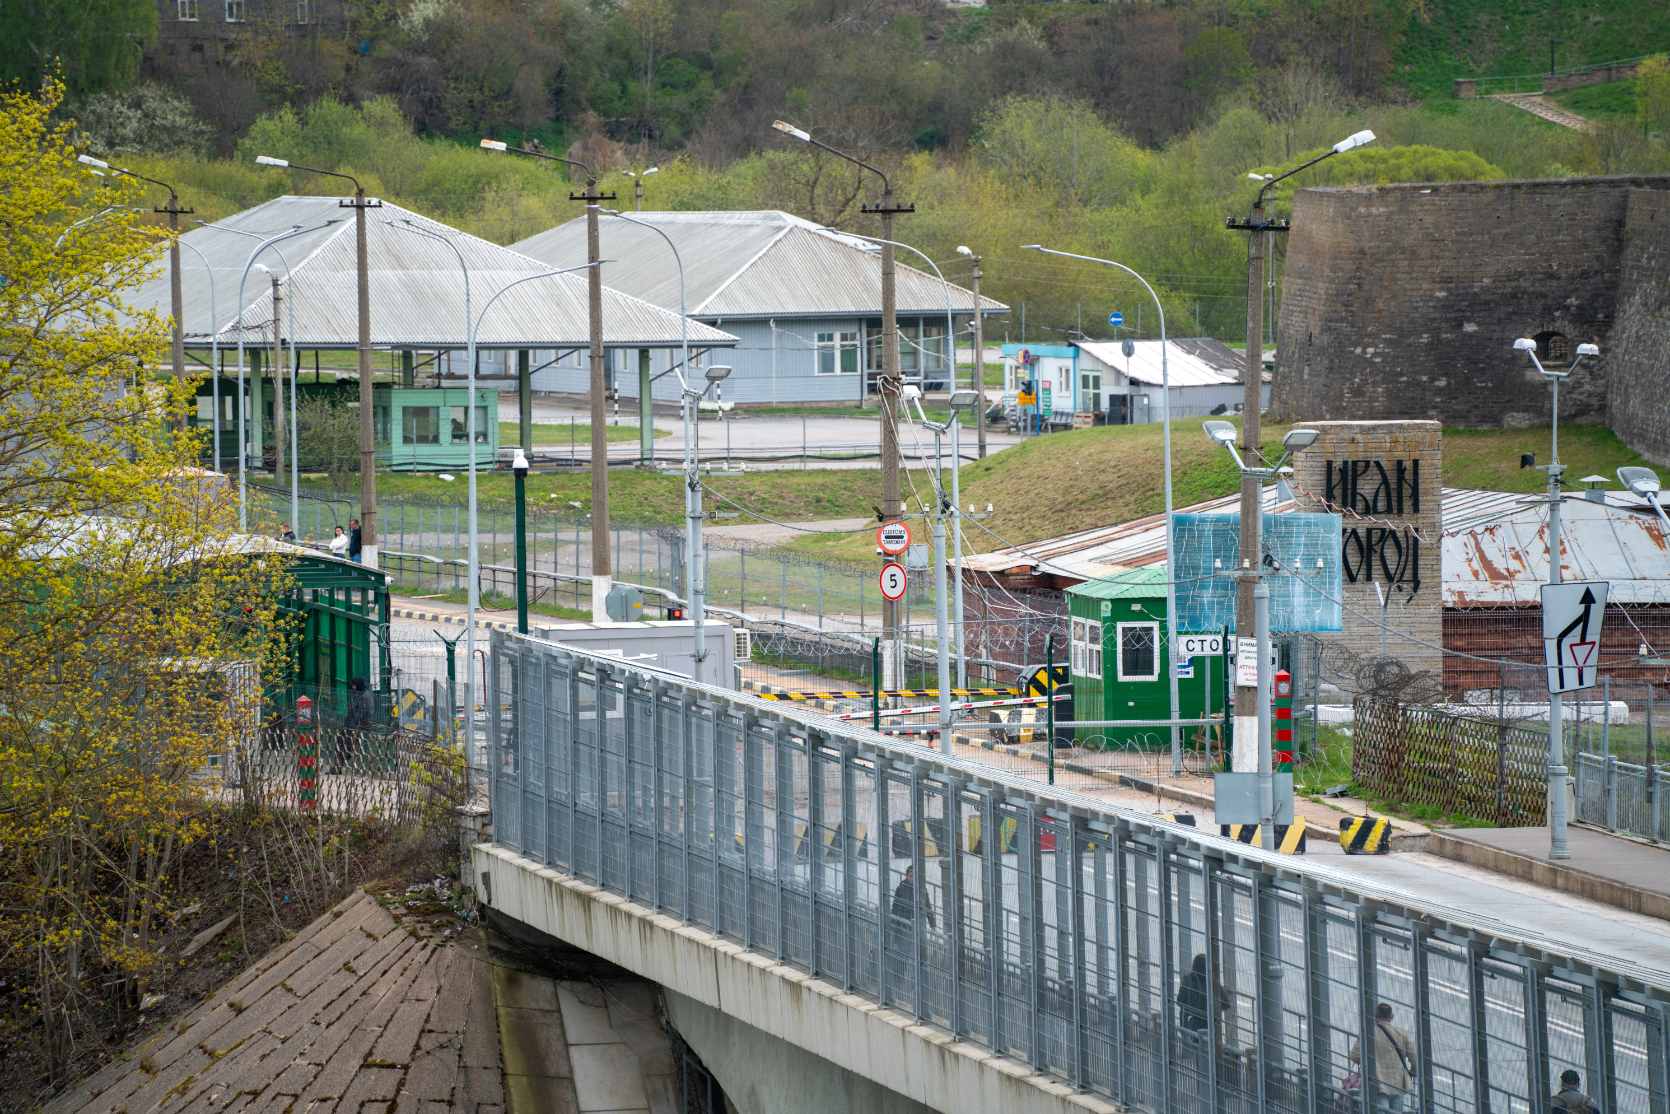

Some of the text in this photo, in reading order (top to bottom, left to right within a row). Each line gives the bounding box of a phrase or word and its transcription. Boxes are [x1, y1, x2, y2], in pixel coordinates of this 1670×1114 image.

[1326, 459, 1419, 514] ИВАН
[889, 573, 898, 589] 5
[1342, 527, 1421, 603] ОРОД
